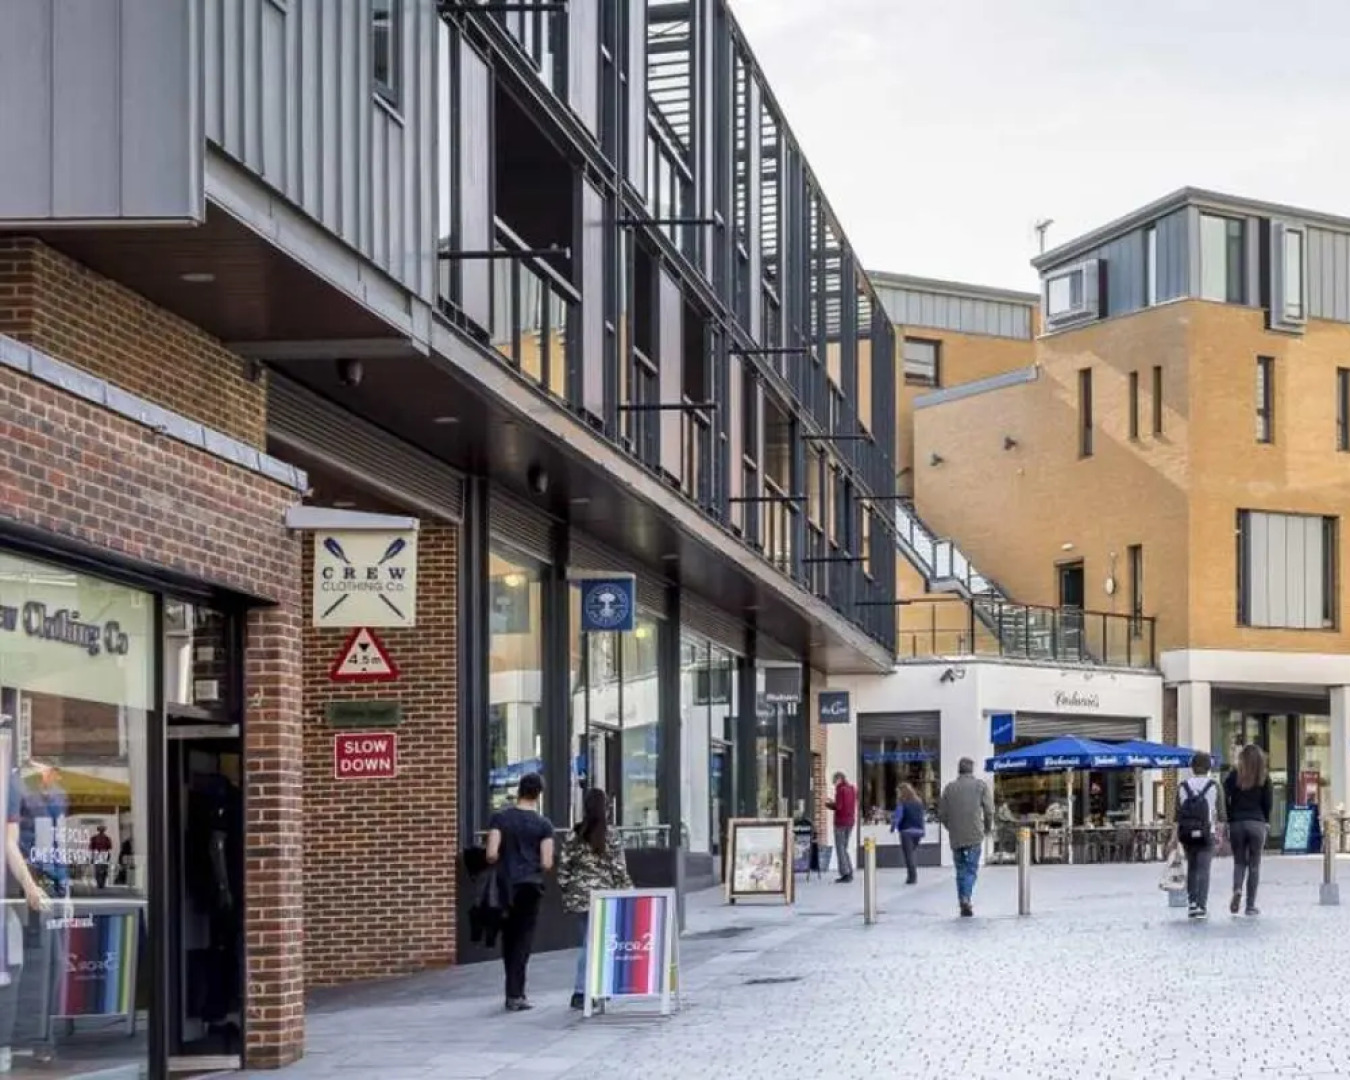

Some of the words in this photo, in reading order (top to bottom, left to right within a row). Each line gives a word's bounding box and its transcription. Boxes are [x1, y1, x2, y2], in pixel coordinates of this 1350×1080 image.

[322, 566, 406, 580] CREW
[321, 581, 383, 592] CLOTHING
[22, 601, 101, 656] Clothing
[345, 740, 388, 754] SLOW
[340, 757, 391, 772] DOWN
